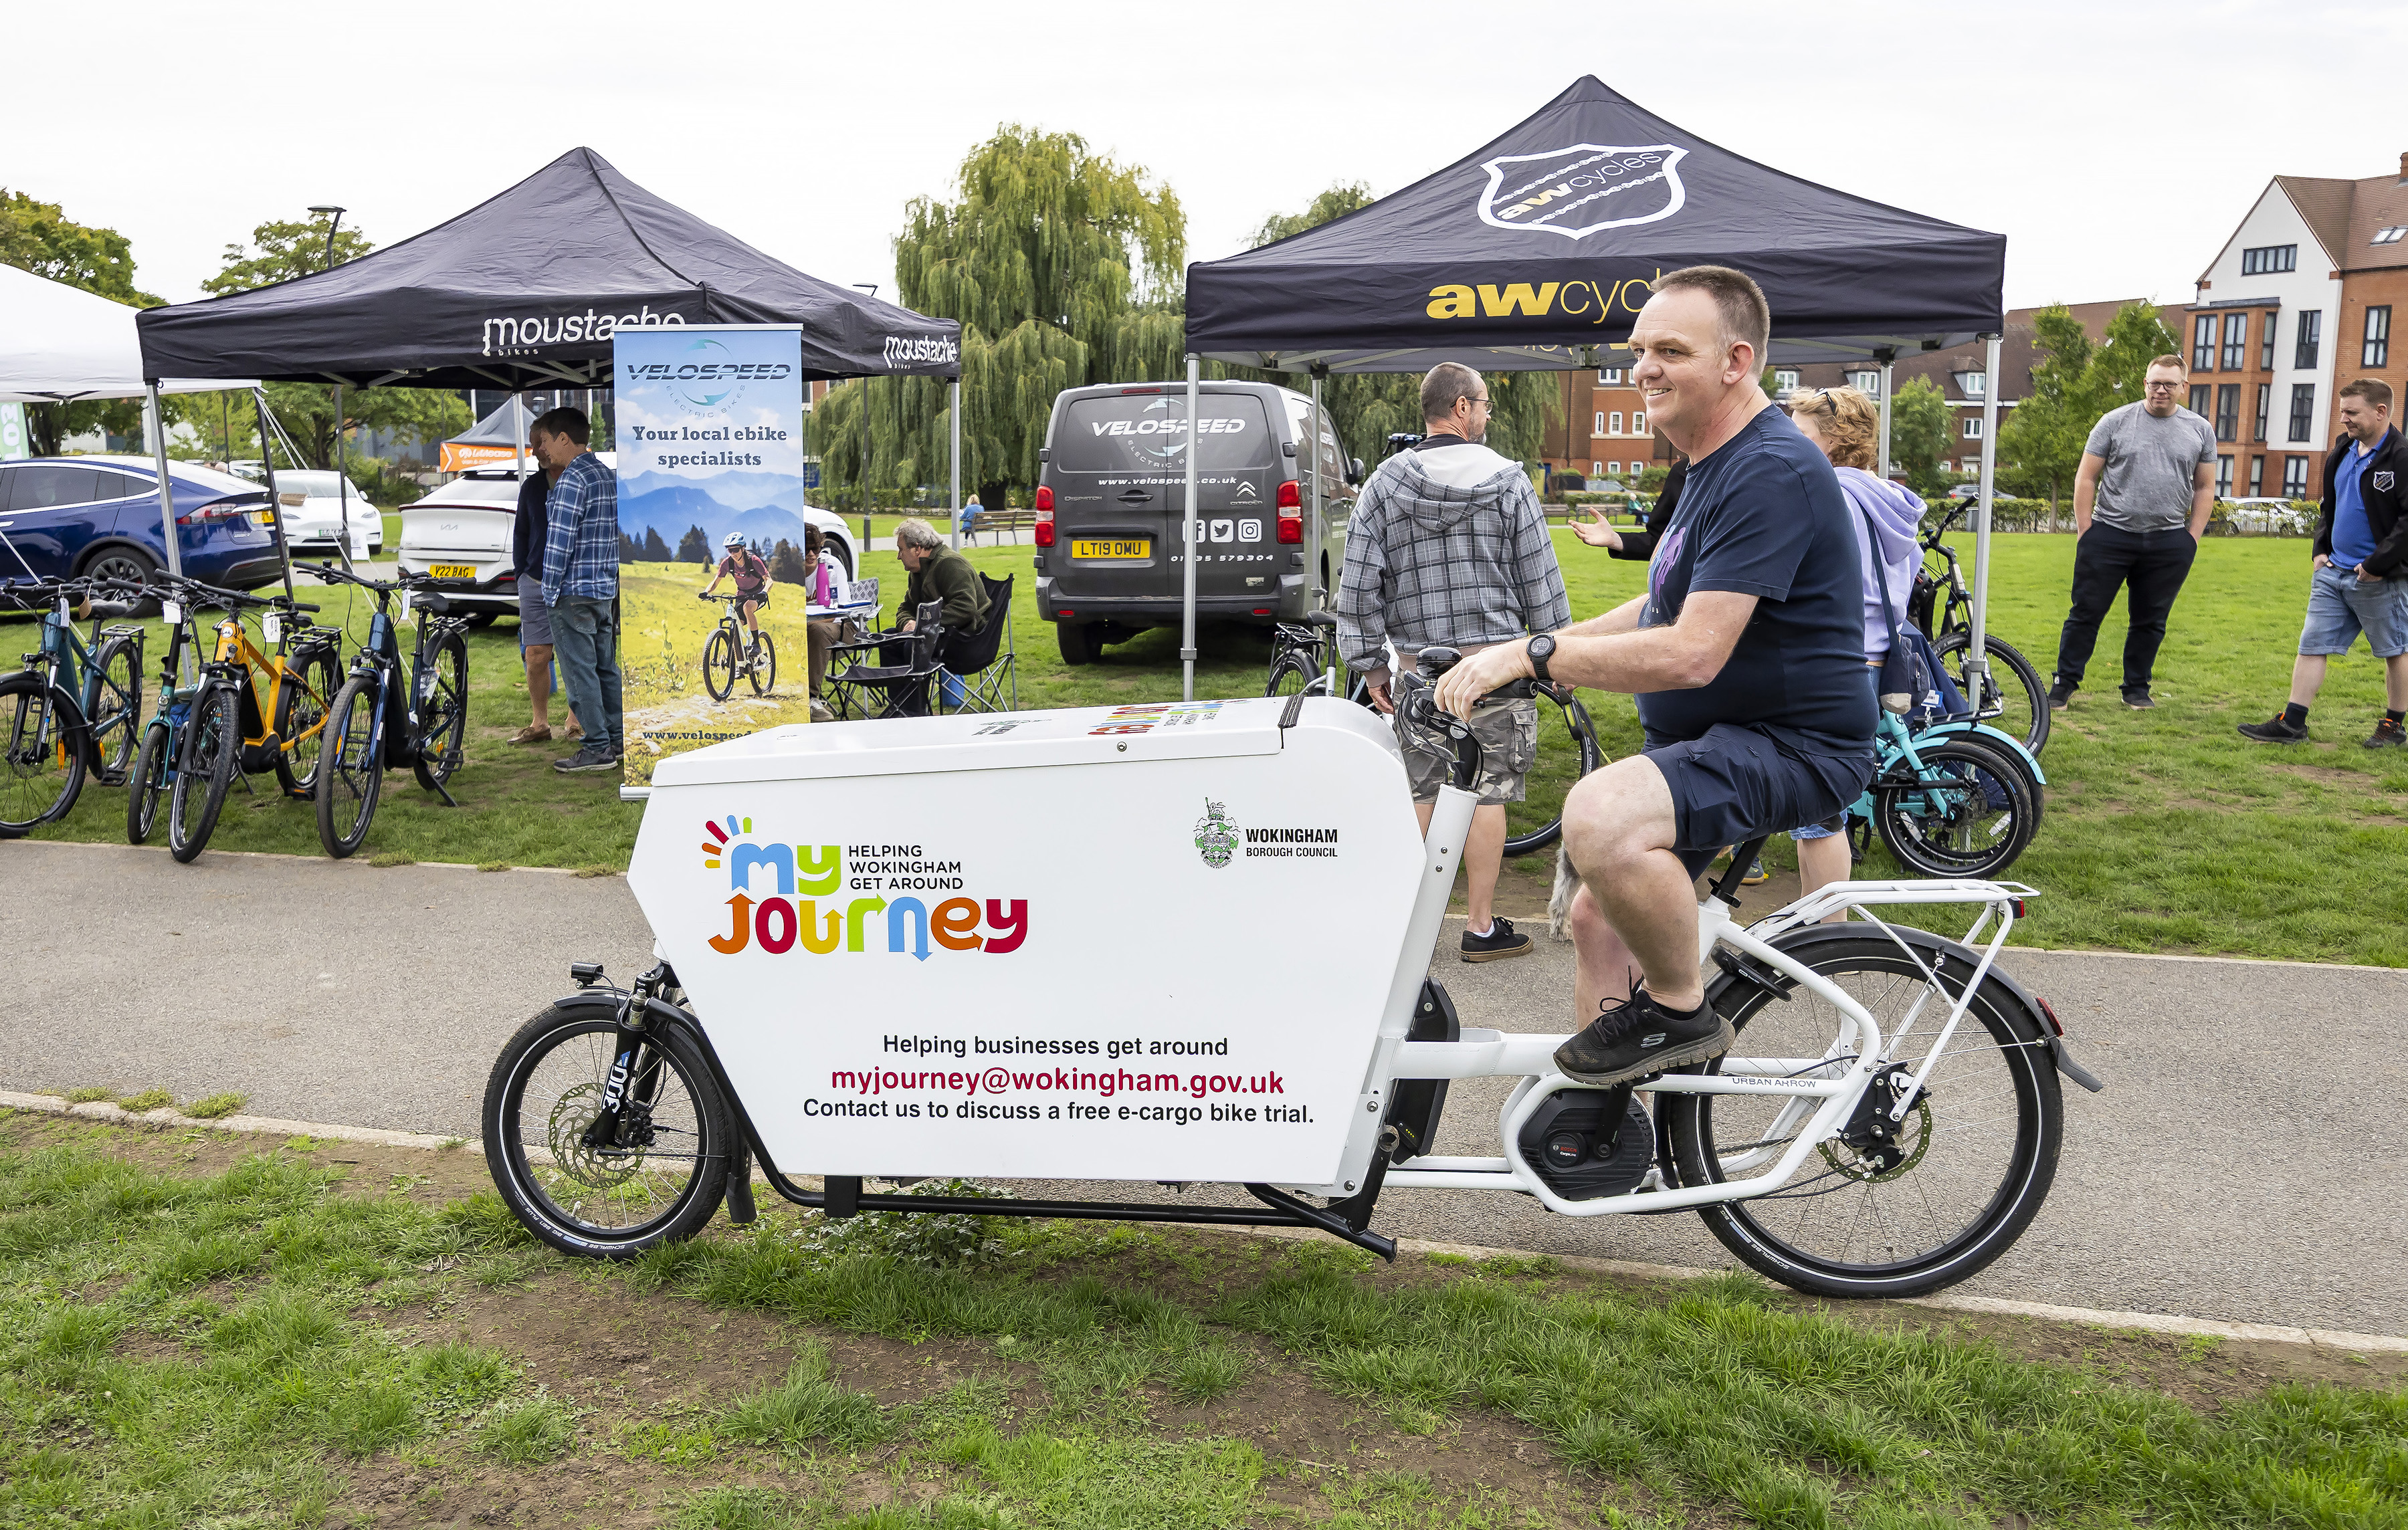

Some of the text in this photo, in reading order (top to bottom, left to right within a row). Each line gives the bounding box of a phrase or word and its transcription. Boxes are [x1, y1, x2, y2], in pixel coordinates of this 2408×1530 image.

[498, 348, 538, 356] bikes
[883, 335, 957, 368] moustache
[627, 364, 791, 380] VELOSPEED
[666, 385, 746, 418] ELECTRIC BIKES
[633, 426, 787, 441] Your local ebike
[658, 451, 761, 468] specialists
[1128, 439, 1173, 468] ELECTRIC
[1098, 477, 1237, 486] www.velospee.co.uk
[1081, 542, 1141, 556] LT19 OMU
[1245, 829, 1338, 843] WOKINGHAM
[849, 845, 922, 857] HELPING
[1246, 847, 1338, 857] BOROUGH COUNCIL
[731, 843, 841, 896] my
[849, 861, 961, 873] WOKINGHAM
[850, 878, 963, 890] GET AROUND
[884, 1034, 1227, 1059] Helping businesses get around
[832, 1066, 1284, 1098] myjourney@wokingham.gov.uk
[1732, 1077, 1816, 1087] URBAN ARROW
[803, 1099, 1314, 1125] Contact us to discuss a free e-cargo bike trial.
[525, 1207, 538, 1221] PLUS
[552, 1228, 563, 1237] BIG
[1750, 1243, 1790, 1270] SCHWALBE
